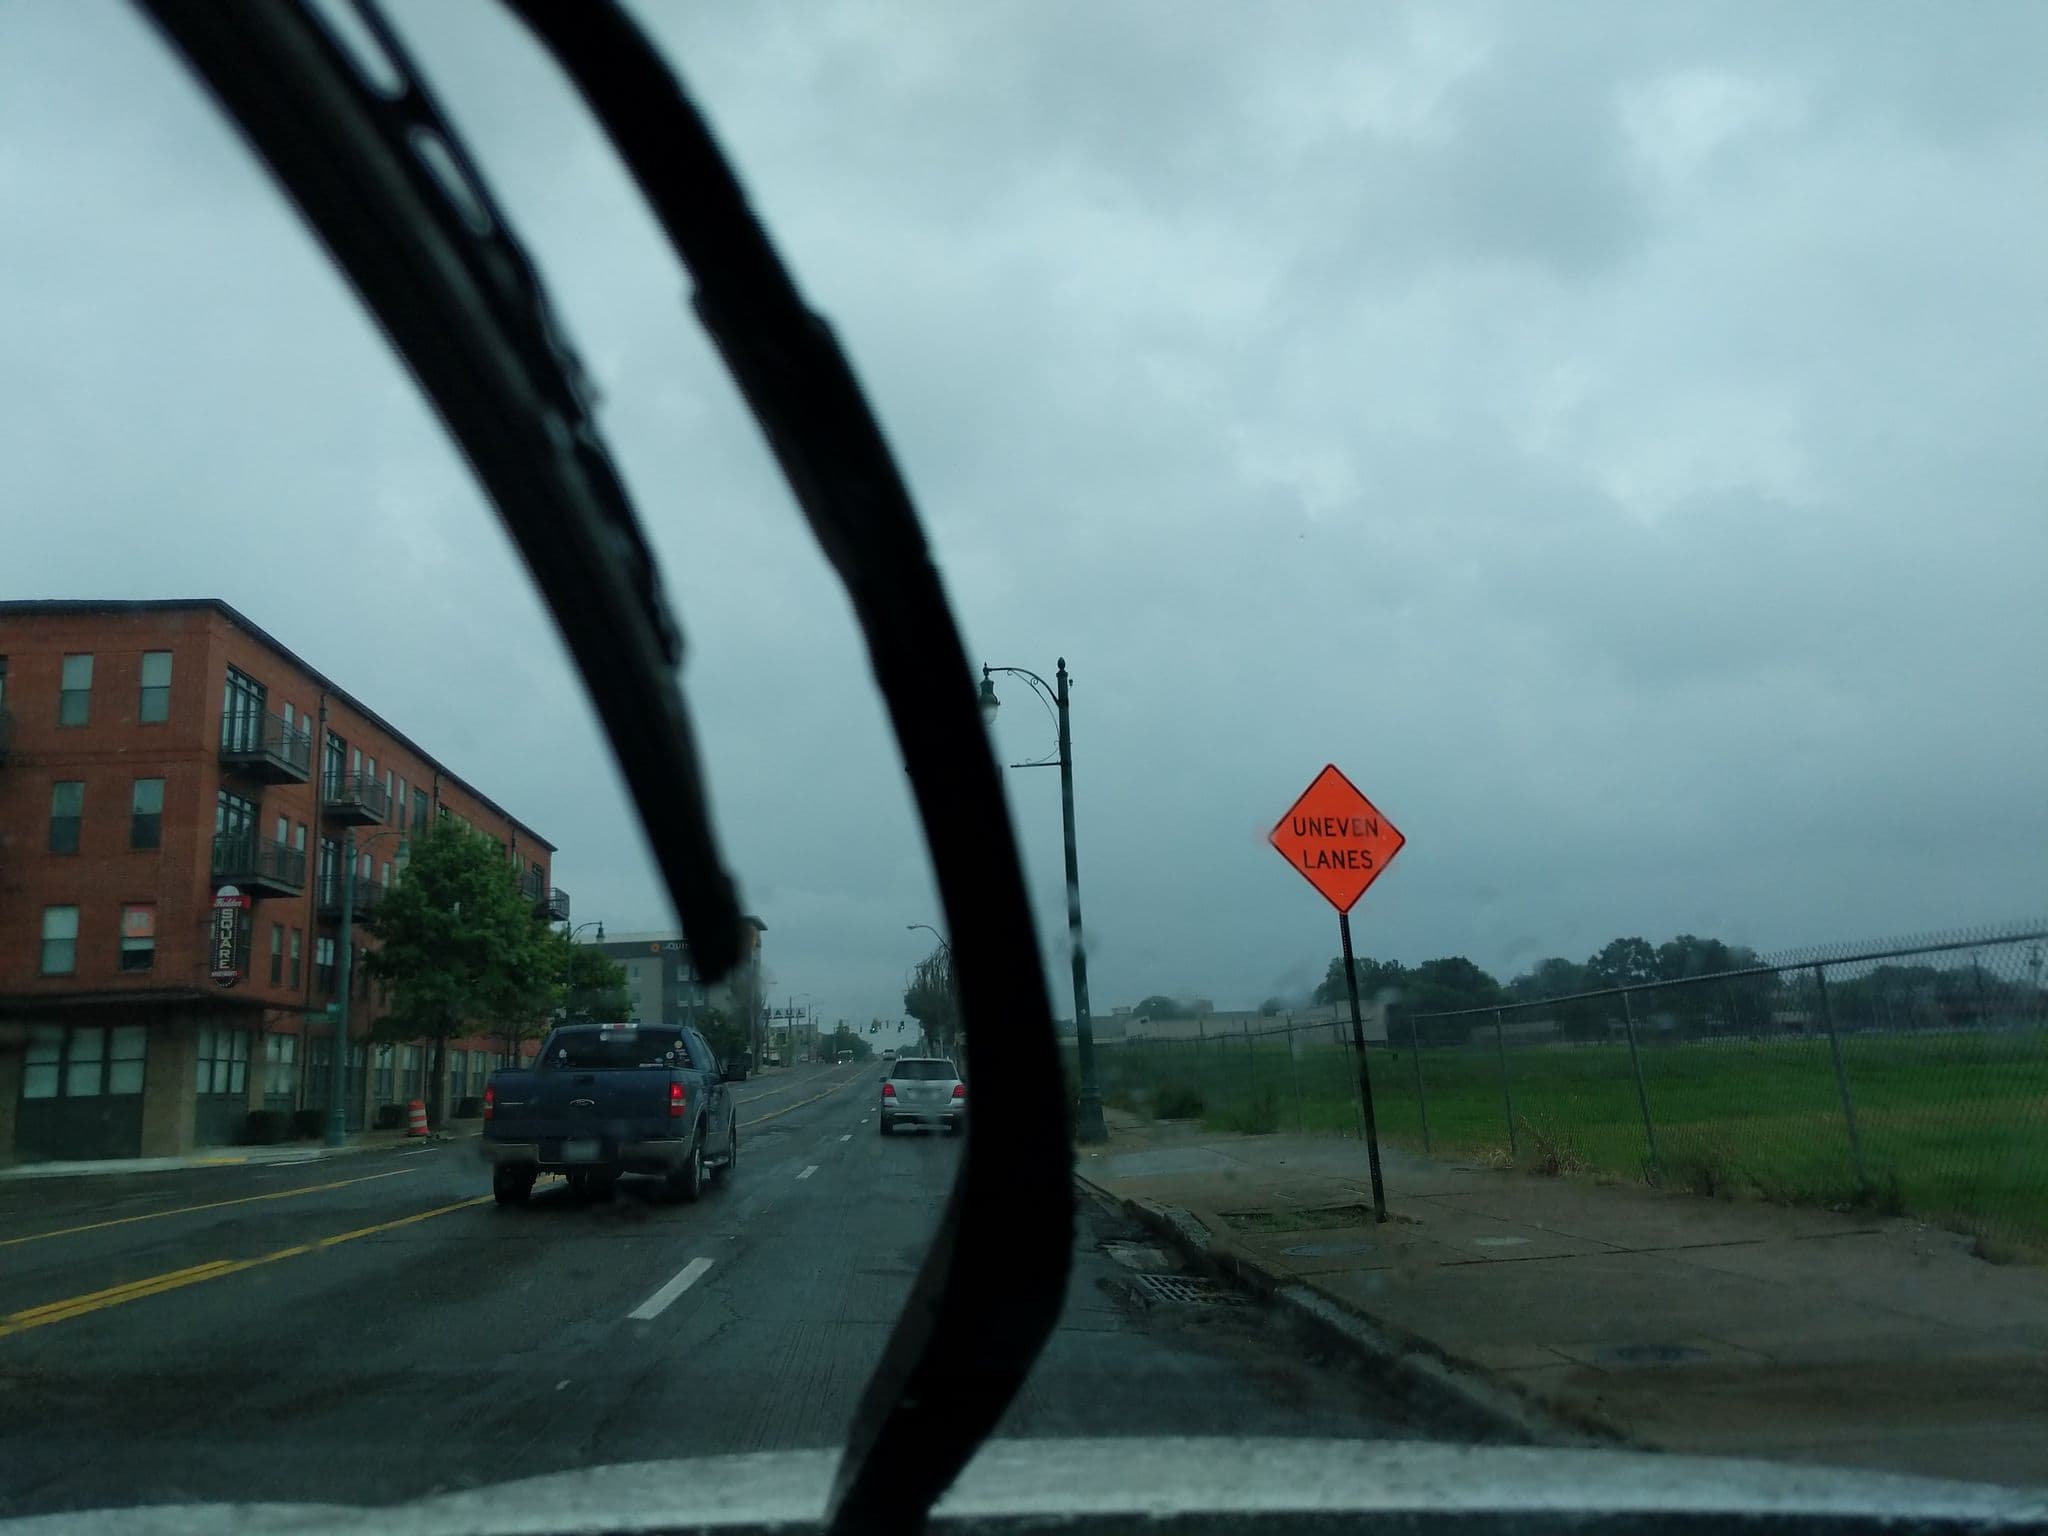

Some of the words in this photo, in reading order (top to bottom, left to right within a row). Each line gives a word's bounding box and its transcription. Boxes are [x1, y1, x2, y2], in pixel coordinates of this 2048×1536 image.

[1294, 816, 1379, 837] UNEVEN
[1303, 850, 1374, 870] LANES
[219, 908, 234, 969] SQUARE
